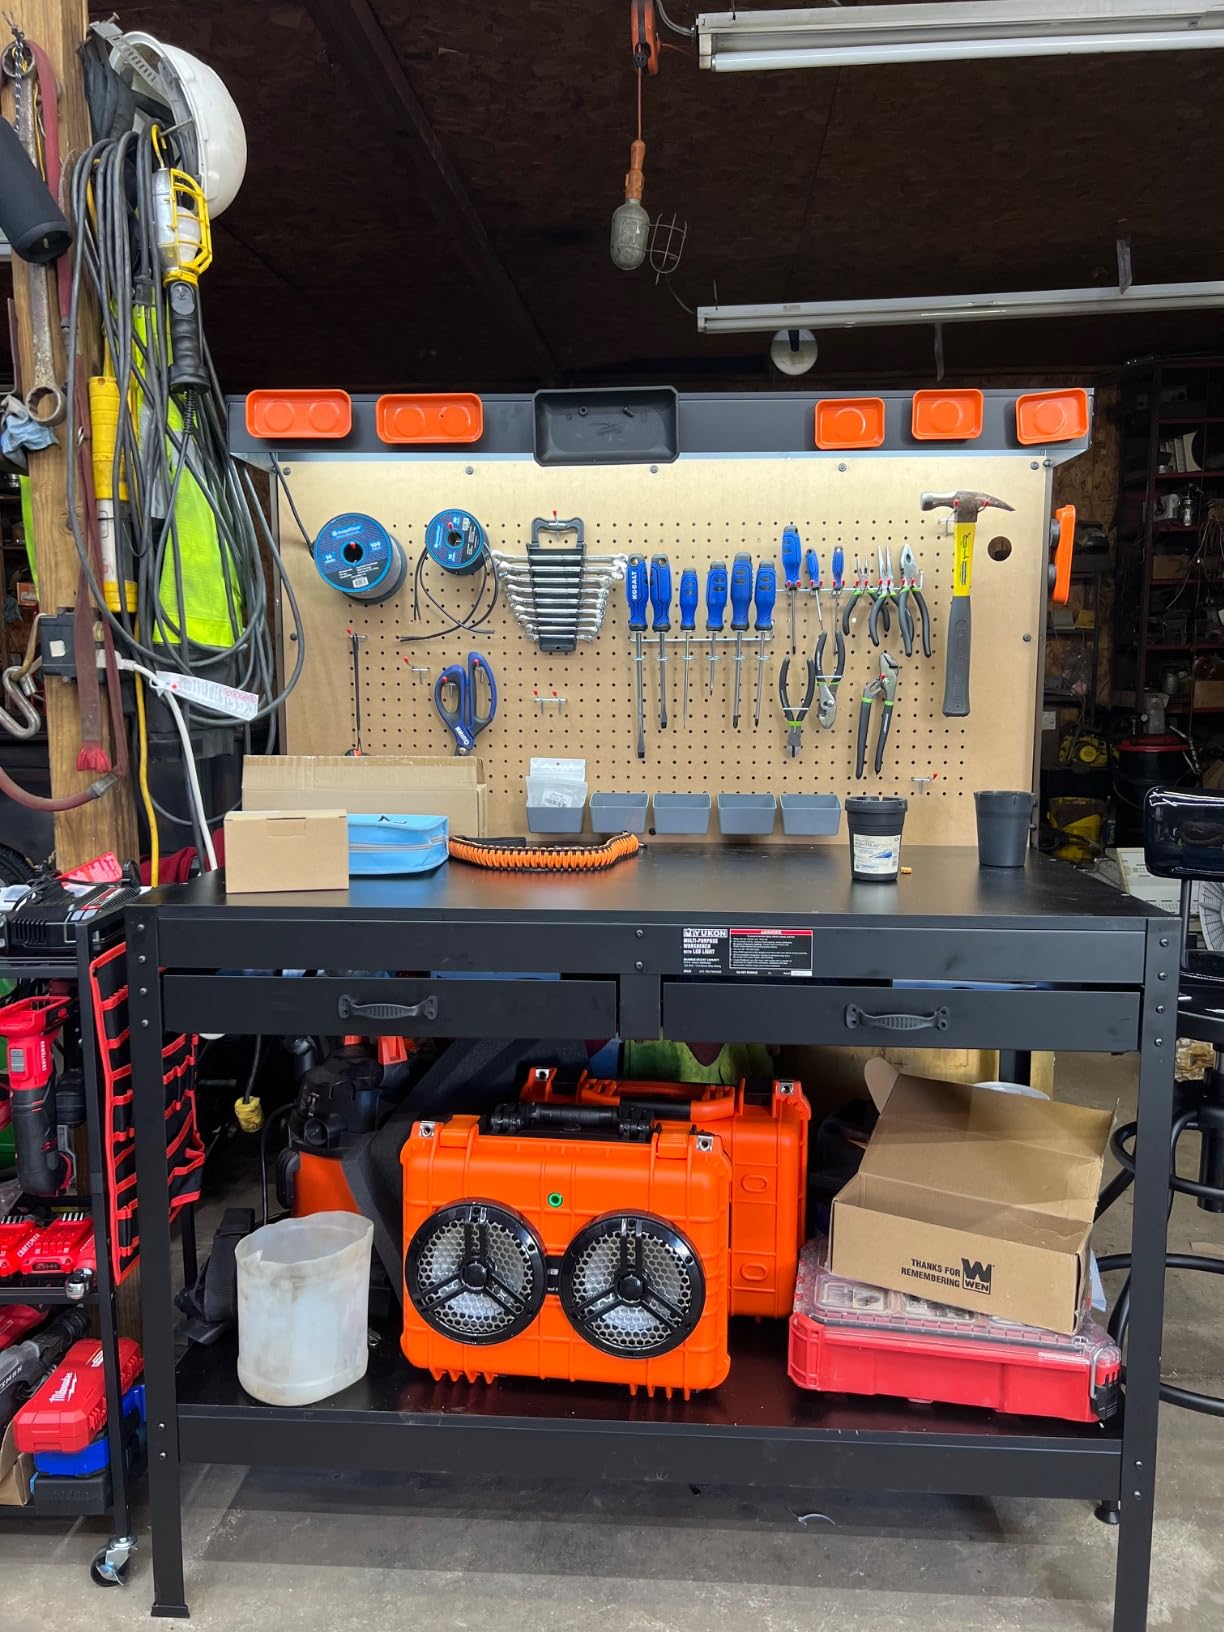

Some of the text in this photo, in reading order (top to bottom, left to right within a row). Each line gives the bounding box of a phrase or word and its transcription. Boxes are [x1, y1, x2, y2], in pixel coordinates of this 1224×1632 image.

[911, 1258, 961, 1277] THANKS FOR
[901, 1267, 960, 1288] REMEMBERING
[965, 1279, 989, 1292] WEN
